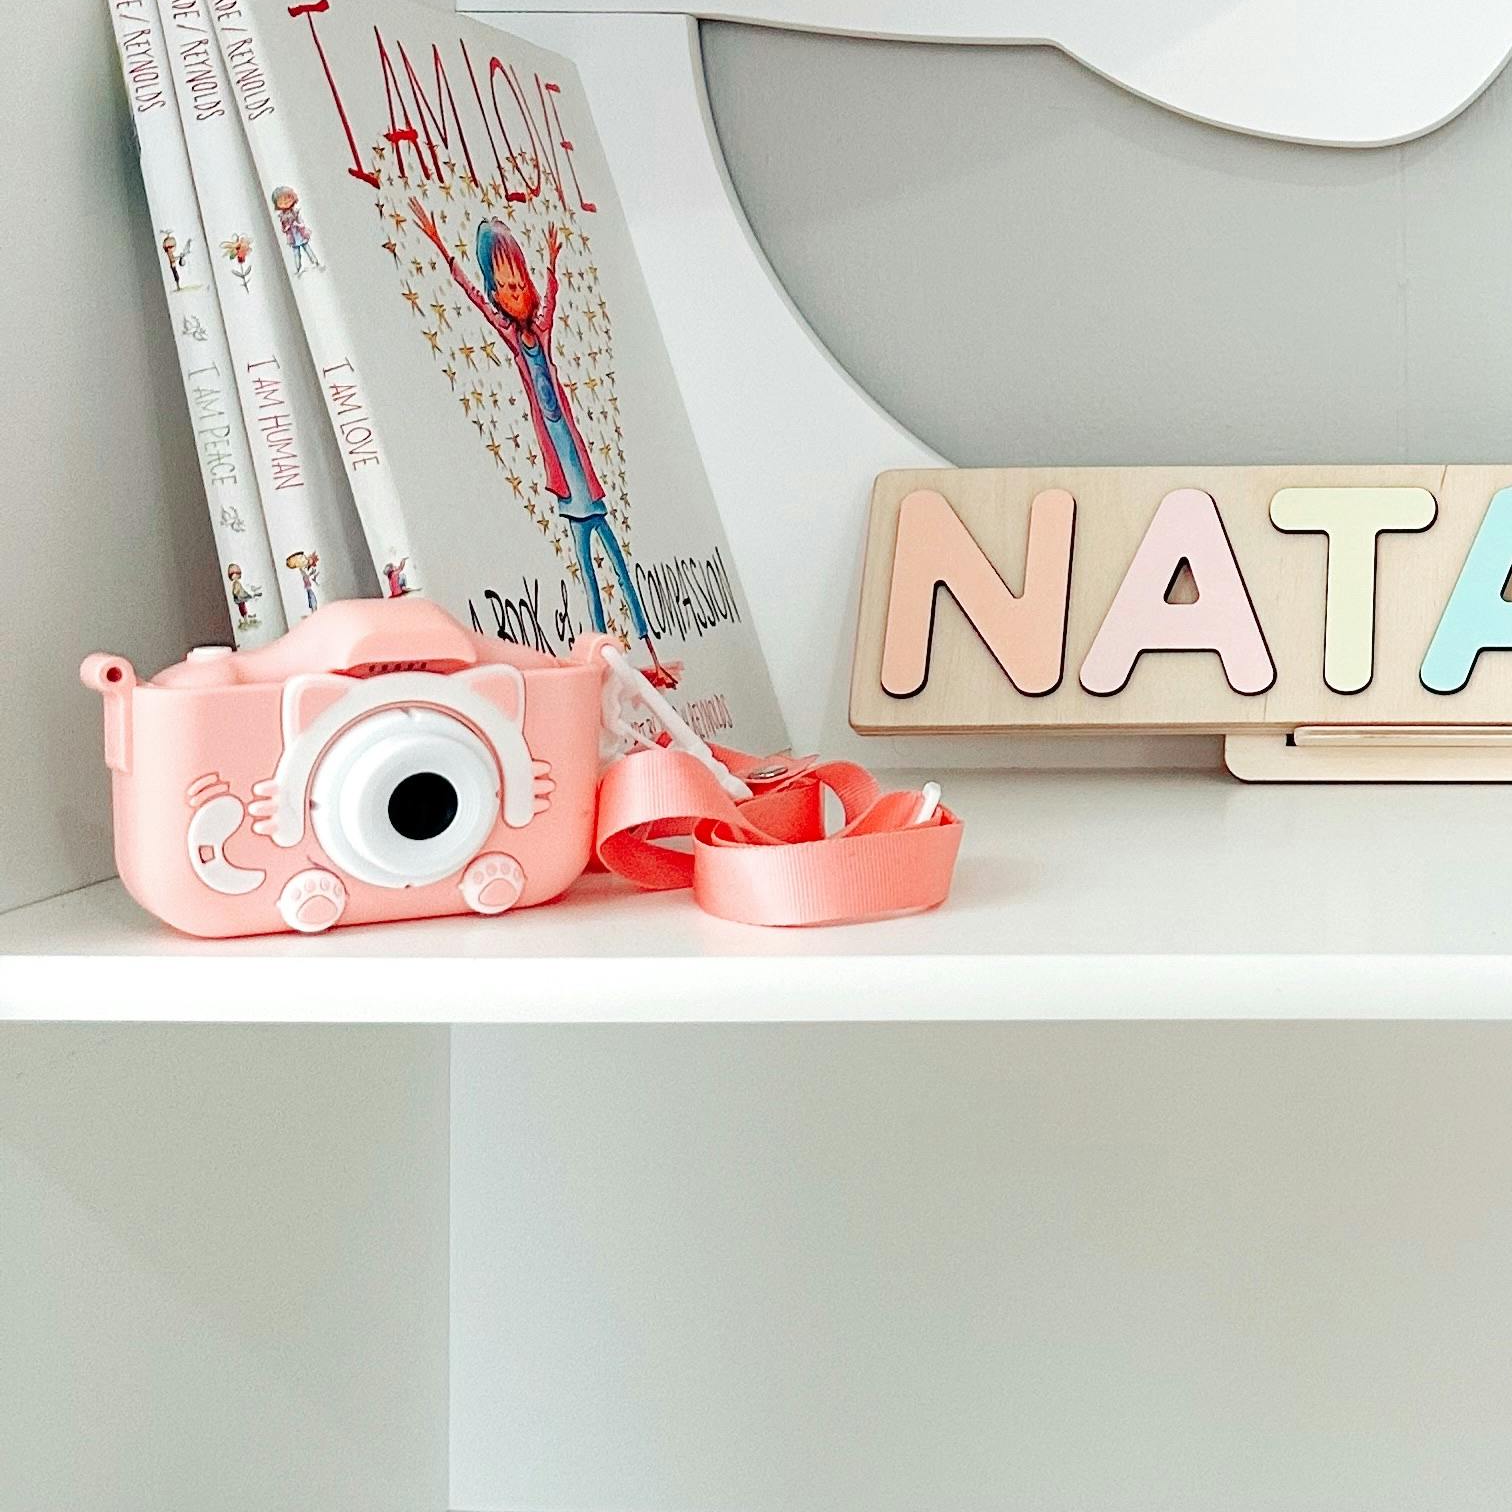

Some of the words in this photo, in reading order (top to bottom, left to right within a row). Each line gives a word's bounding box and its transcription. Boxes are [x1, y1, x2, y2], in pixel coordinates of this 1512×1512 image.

[122, 28, 167, 113] REYNOLDS
[179, 38, 225, 121] REYNOLDS
[226, 37, 275, 121] REYNOLDS
[372, 25, 479, 189] AM
[459, 38, 597, 213] LOVE
[187, 361, 221, 381] I
[247, 354, 280, 374] I
[252, 377, 285, 409] AM
[322, 356, 355, 379] I
[192, 385, 225, 422] AM
[328, 383, 363, 416] AM
[197, 423, 238, 488] PEACE
[257, 413, 305, 491] HUMAN
[339, 417, 380, 472] LOVE
[635, 546, 742, 642] COMPASSION
